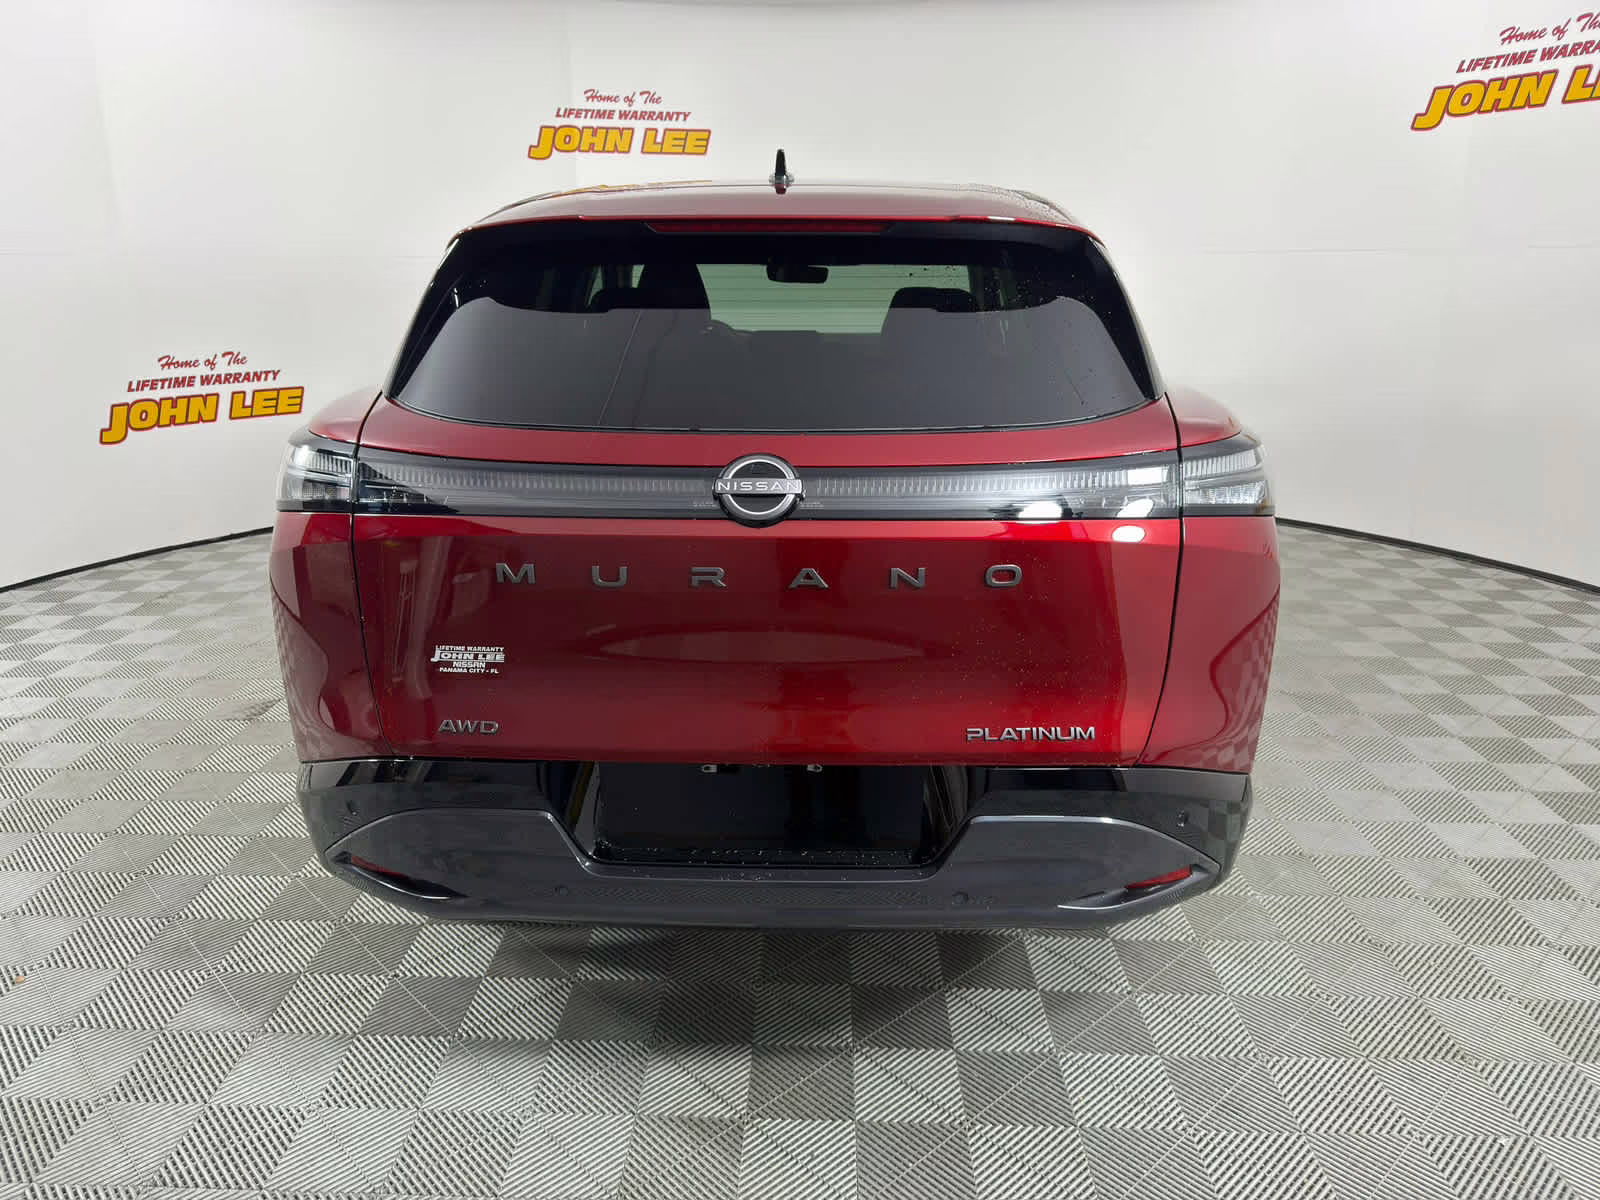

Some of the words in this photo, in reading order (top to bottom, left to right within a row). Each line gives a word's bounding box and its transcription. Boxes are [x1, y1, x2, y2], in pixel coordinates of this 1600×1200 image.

[1500, 26, 1548, 45] Home
[1551, 18, 1572, 41] of
[1576, 12, 1600, 32] Th
[1456, 49, 1538, 74] LIFETIME
[583, 88, 620, 104] Home
[623, 92, 636, 107] of
[639, 90, 662, 105] The
[1411, 69, 1559, 131] JOHN
[1561, 64, 1600, 104] L
[555, 107, 616, 120] LIFETIME
[618, 109, 692, 122] WARRANTY
[527, 125, 634, 160] JOHN
[640, 128, 711, 156] LEE
[157, 355, 200, 370] Home
[204, 354, 217, 369] of
[221, 351, 247, 367] The
[127, 375, 197, 393] LIFETIME
[199, 369, 281, 387] WARRANTY
[99, 393, 220, 444] JOHN
[228, 386, 304, 420] LEE
[717, 481, 799, 491] NISSAN
[495, 563, 1023, 589] MURANO
[430, 649, 474, 662] JOHN
[477, 653, 504, 661] LEE
[438, 719, 499, 734] AWD
[966, 726, 1097, 742] PLATINUM
